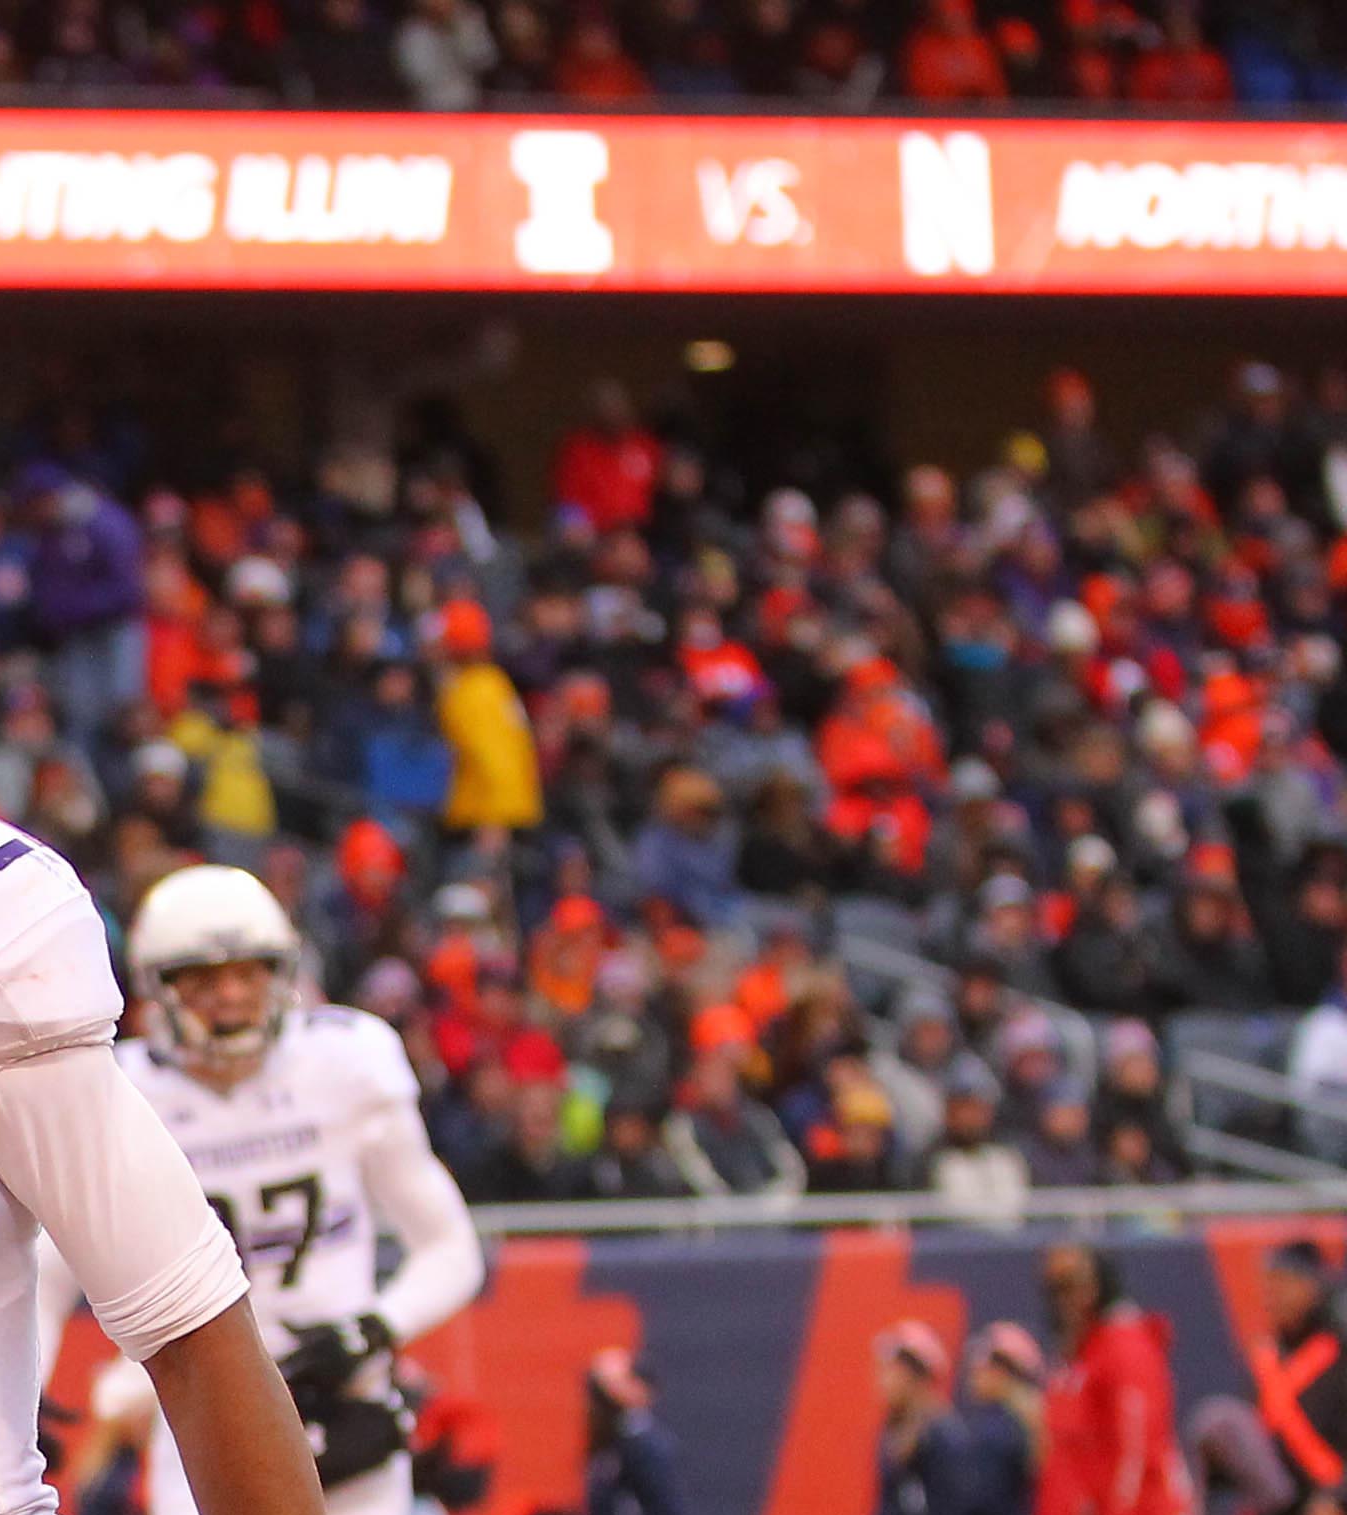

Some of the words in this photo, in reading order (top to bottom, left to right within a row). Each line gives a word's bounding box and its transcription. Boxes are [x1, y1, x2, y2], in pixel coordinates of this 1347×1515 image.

[224, 153, 454, 245] ILLINI
[898, 131, 994, 276] N
[1057, 161, 1347, 250] NORTH
